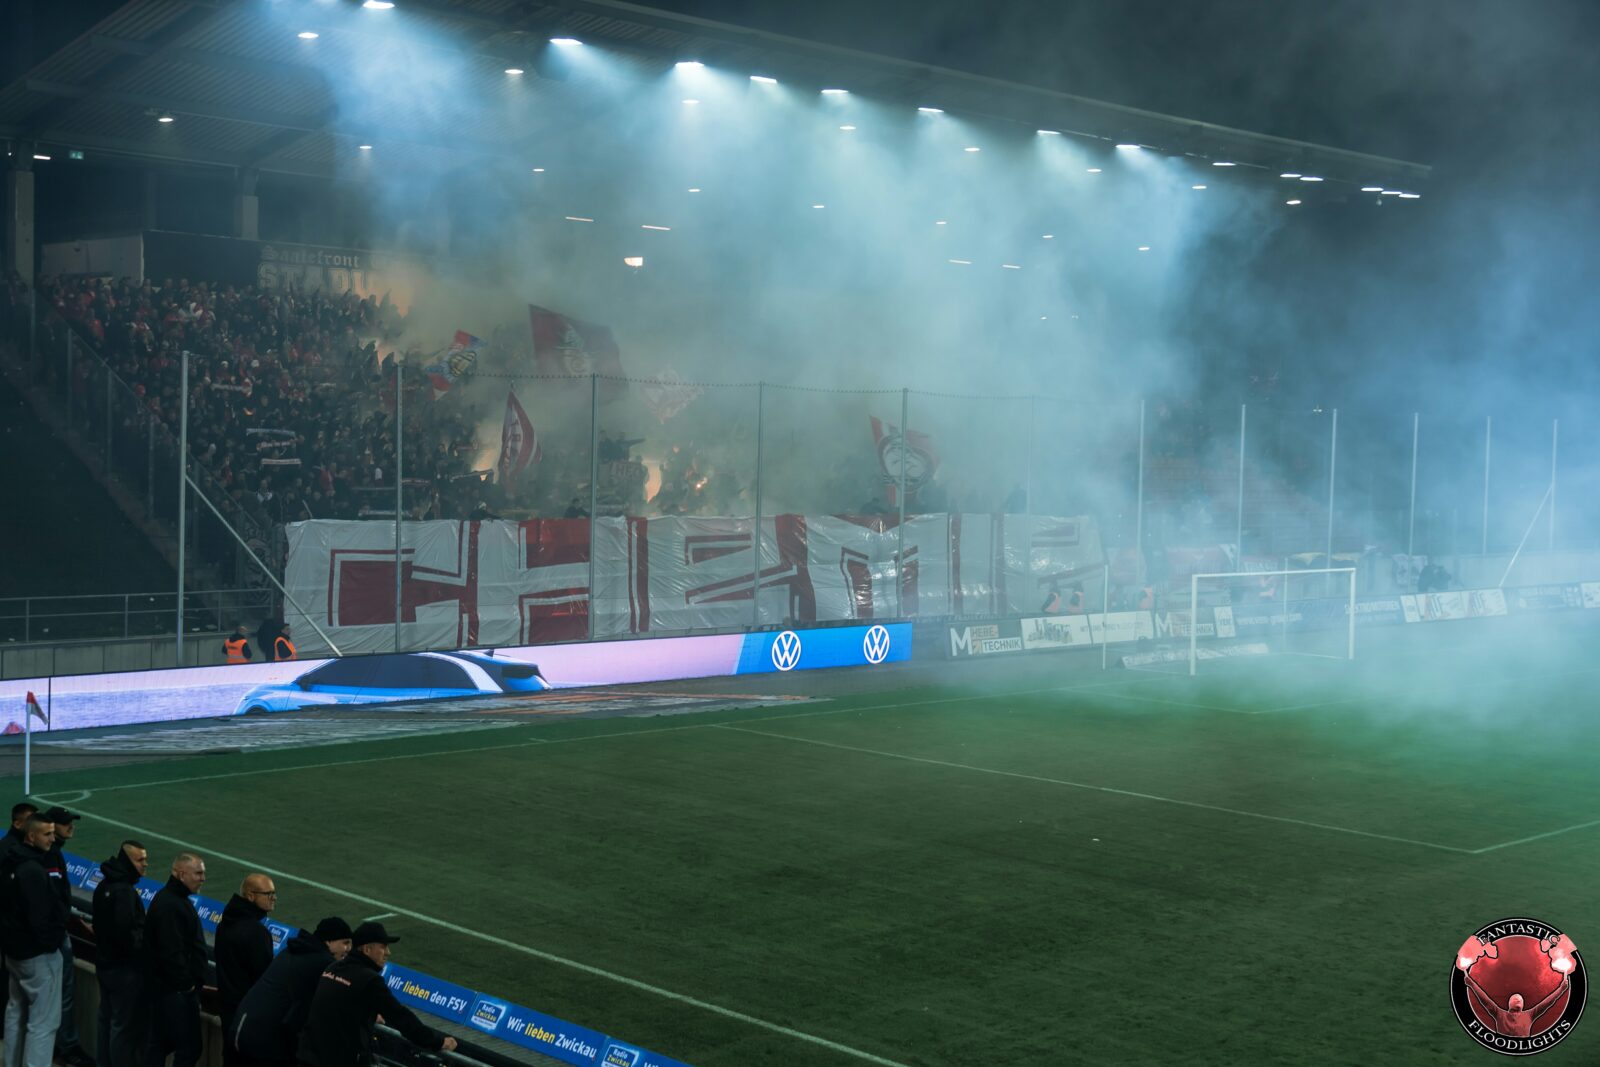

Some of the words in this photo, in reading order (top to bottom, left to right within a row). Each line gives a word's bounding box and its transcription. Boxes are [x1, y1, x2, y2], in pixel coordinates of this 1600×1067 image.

[983, 638, 1021, 653] TECHNIK
[197, 906, 211, 919] Wir
[387, 974, 404, 990] Wir
[402, 980, 430, 1000] lieben
[430, 991, 448, 1006] den
[447, 996, 467, 1012] FSV
[476, 1009, 497, 1022] Zwickau
[482, 1004, 496, 1014] Radio
[506, 1016, 525, 1033] Wir
[524, 1023, 556, 1044] lieben
[555, 1033, 597, 1059] Zwickau
[613, 1048, 628, 1059] Radio
